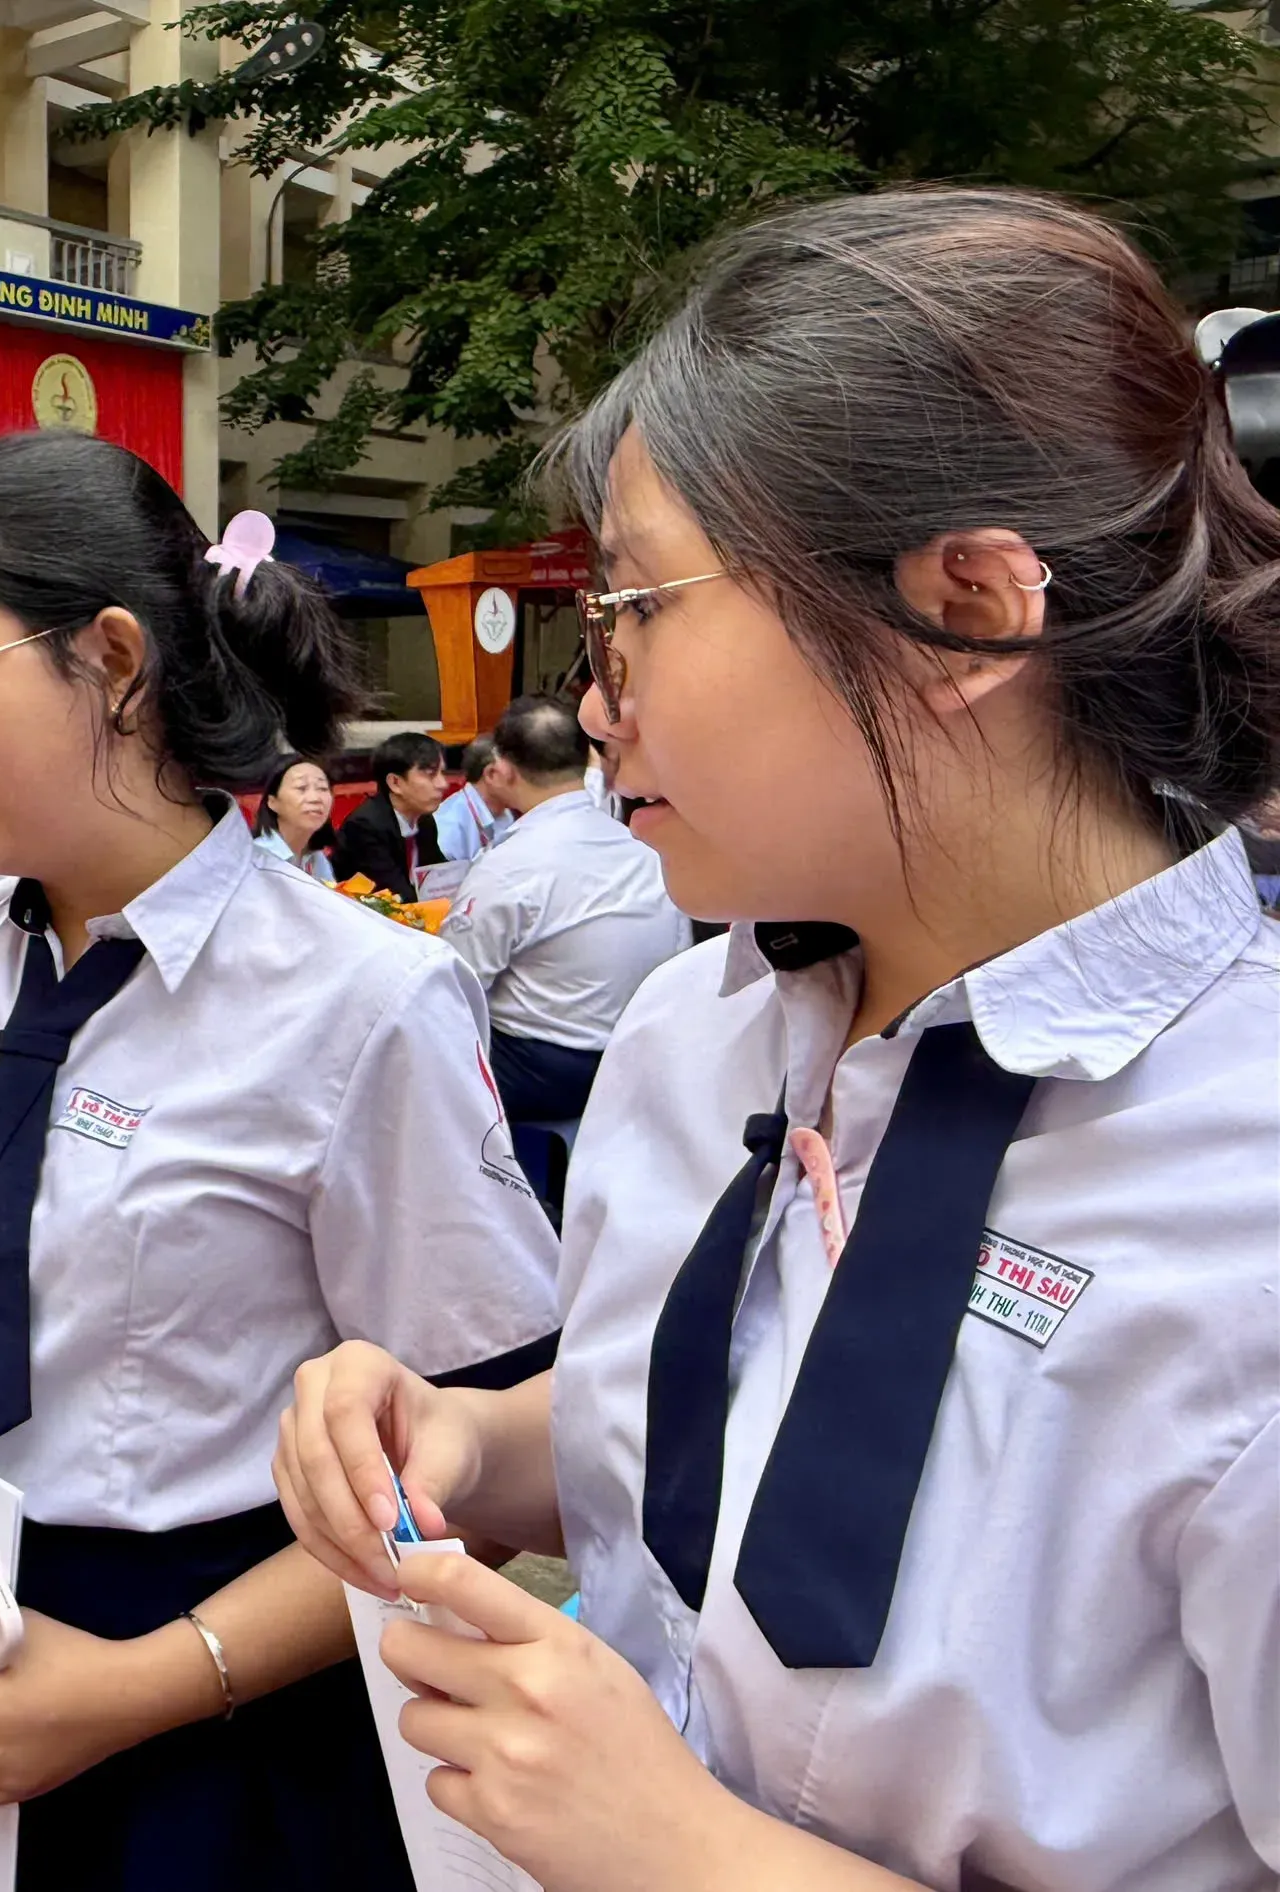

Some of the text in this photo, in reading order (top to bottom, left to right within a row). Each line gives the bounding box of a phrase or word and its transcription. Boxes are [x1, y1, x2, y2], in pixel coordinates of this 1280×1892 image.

[39, 289, 91, 319] ĐỊNH
[97, 300, 149, 331] MÌNH
[977, 1244, 1075, 1304] Õ THỊ SÁU
[987, 1291, 1019, 1318] THƯ
